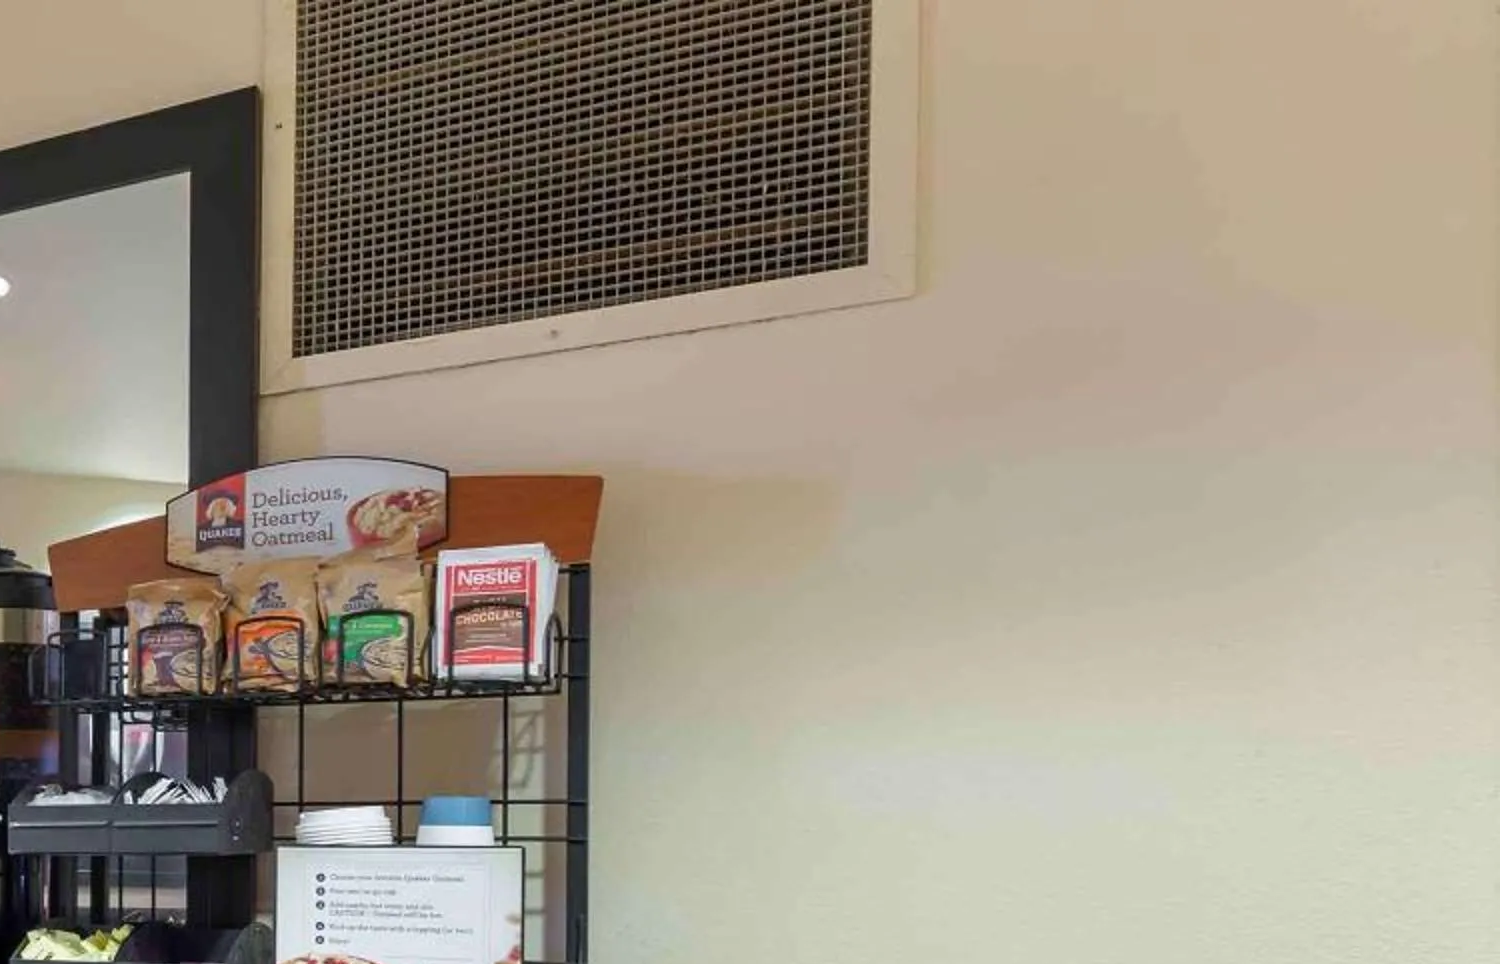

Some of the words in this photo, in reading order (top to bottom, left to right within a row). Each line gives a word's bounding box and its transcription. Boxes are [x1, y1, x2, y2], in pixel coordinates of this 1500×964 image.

[252, 487, 349, 508] Delicious,
[252, 509, 320, 528] Hearty
[252, 521, 333, 547] Oatmeal
[456, 610, 524, 626] CHOCOLATE
